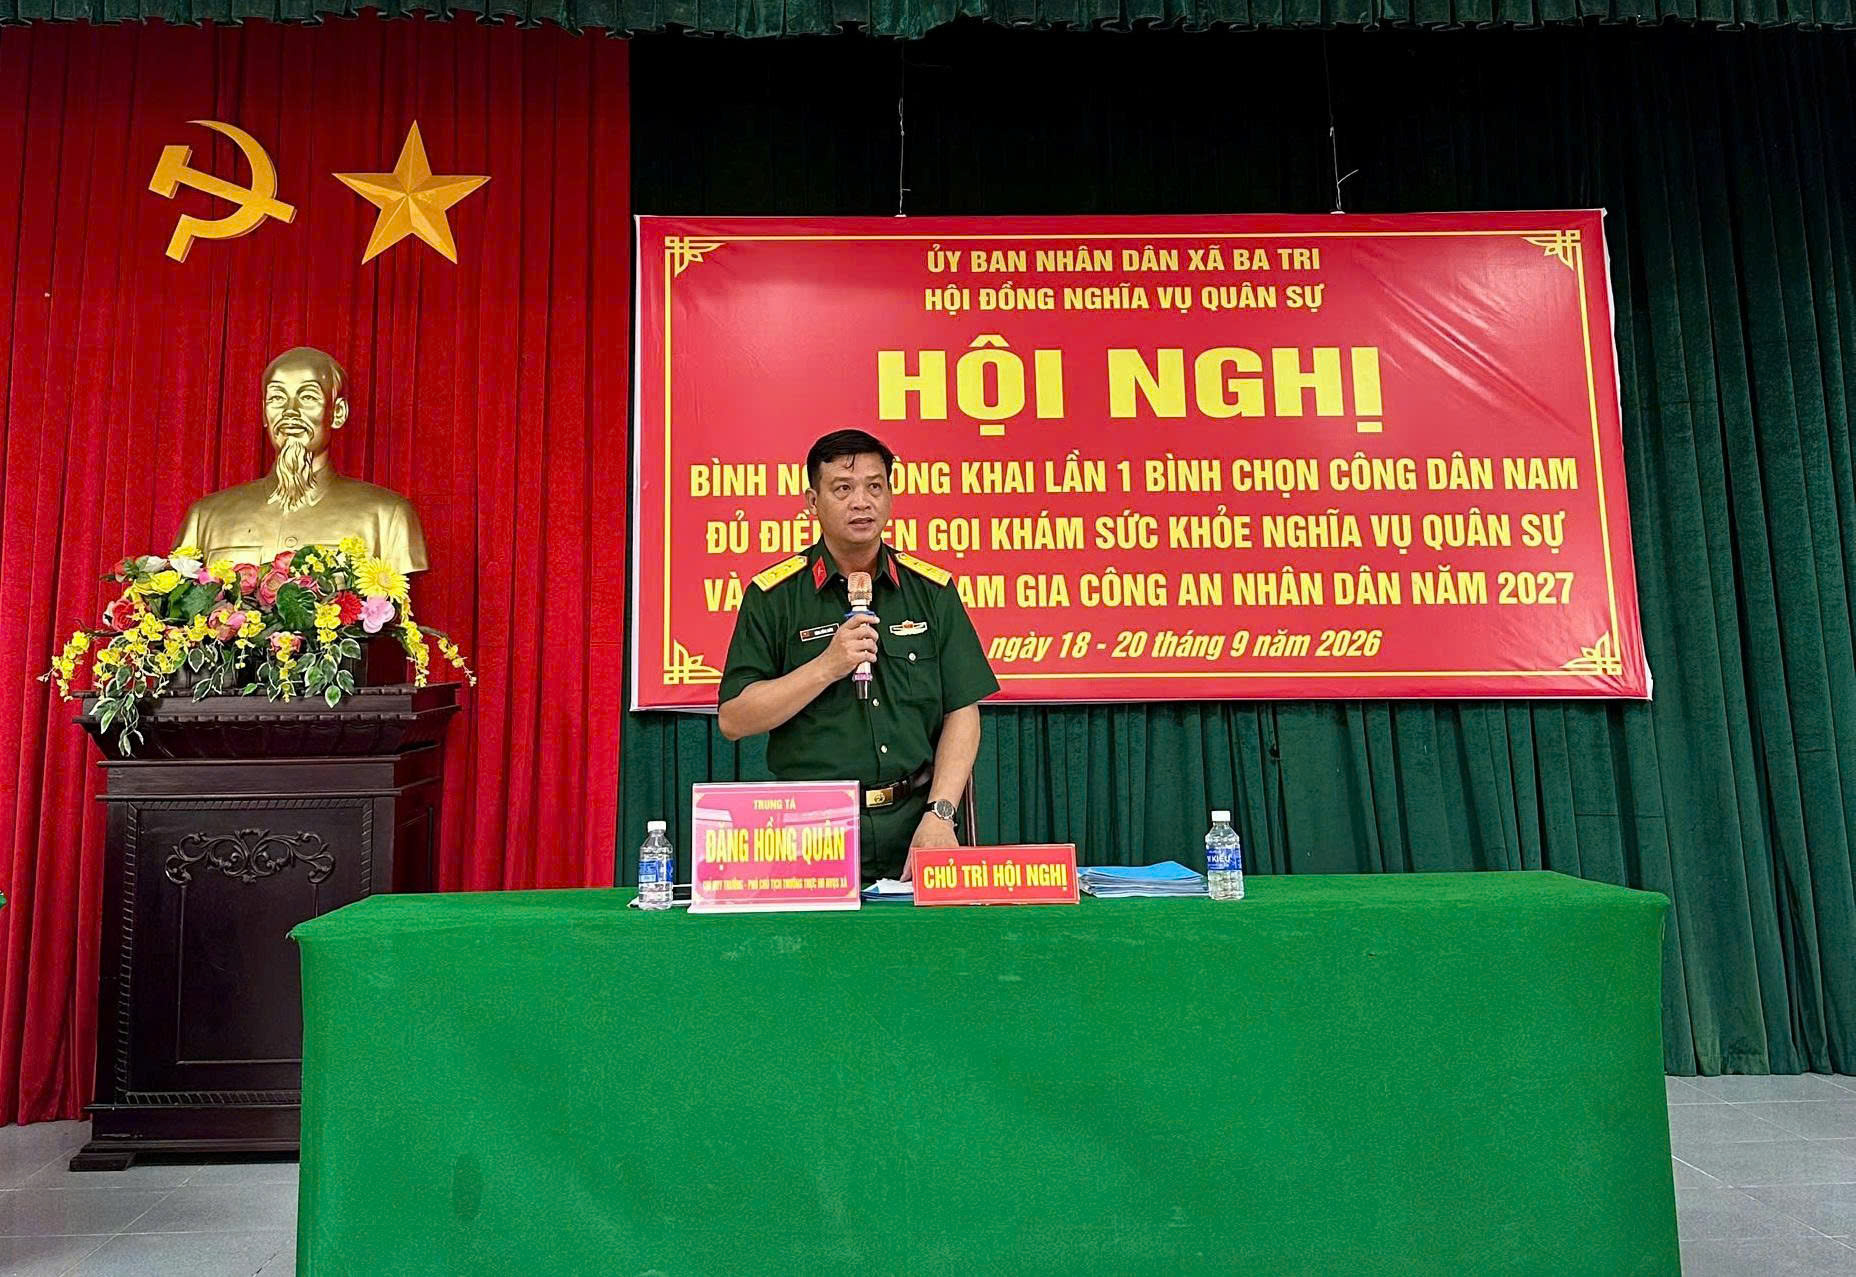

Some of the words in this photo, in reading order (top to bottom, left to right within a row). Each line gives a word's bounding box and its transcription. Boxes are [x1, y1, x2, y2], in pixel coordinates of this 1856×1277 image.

[927, 243, 961, 272] ỦY
[971, 250, 1027, 272] BAN
[1036, 246, 1113, 271] NHÂN
[1122, 247, 1179, 270] DÂN
[1188, 246, 1225, 271] XÃ
[1233, 248, 1270, 270] BA
[1279, 248, 1320, 270] TRI
[925, 284, 970, 316] HỘI
[979, 281, 1055, 311] ĐỒNG
[1063, 283, 1149, 310] NGHĨA
[1157, 287, 1192, 313] VỤ
[1201, 282, 1277, 312] QUÂN
[1286, 284, 1325, 313] SỰ
[877, 334, 1065, 436] HỘI
[1107, 346, 1384, 433] NGHỊ
[690, 458, 767, 497] BÌNH
[889, 455, 951, 495] ÔNG
[961, 461, 1035, 494] KHAI
[1045, 449, 1106, 493] LẦN
[1117, 461, 1131, 492] 1
[1145, 453, 1222, 492] BÌNH
[1231, 458, 1319, 498] CHỌN
[1329, 451, 1417, 491] CÔNG
[1426, 451, 1494, 490] DÂN
[1502, 457, 1579, 490] NAM
[705, 509, 749, 554] ĐỦ
[928, 517, 981, 560] GỌI
[991, 510, 1085, 550] KHÁM
[1095, 505, 1159, 550] SỨC
[1168, 505, 1253, 549] KHỎE
[1262, 508, 1363, 549] NGHĨA
[1370, 514, 1412, 555] VỤ
[1422, 507, 1512, 551] QUÂN
[1521, 511, 1566, 554] SỰ
[703, 571, 744, 613] VÀ
[956, 574, 1006, 609] AM
[1016, 574, 1071, 608] GIA
[1079, 566, 1168, 608] CÔNG
[1177, 573, 1223, 606] AN
[1232, 565, 1324, 606] NHÂN
[1333, 565, 1401, 606] DÂN
[1411, 564, 1488, 605] NĂM
[1497, 571, 1575, 605] 2027
[986, 631, 1054, 663] ngày
[1059, 631, 1093, 659] 18
[1111, 631, 1147, 658] 20
[1151, 629, 1226, 661] tháng
[1230, 629, 1249, 657] 9
[1253, 628, 1311, 657] năm
[1314, 629, 1384, 657] 2026
[801, 817, 846, 866] QUÂN
[923, 858, 958, 889] CHỦ
[961, 860, 989, 888] TRÌ
[993, 860, 1022, 892] HỘI
[1026, 863, 1068, 892] NGHỊ
